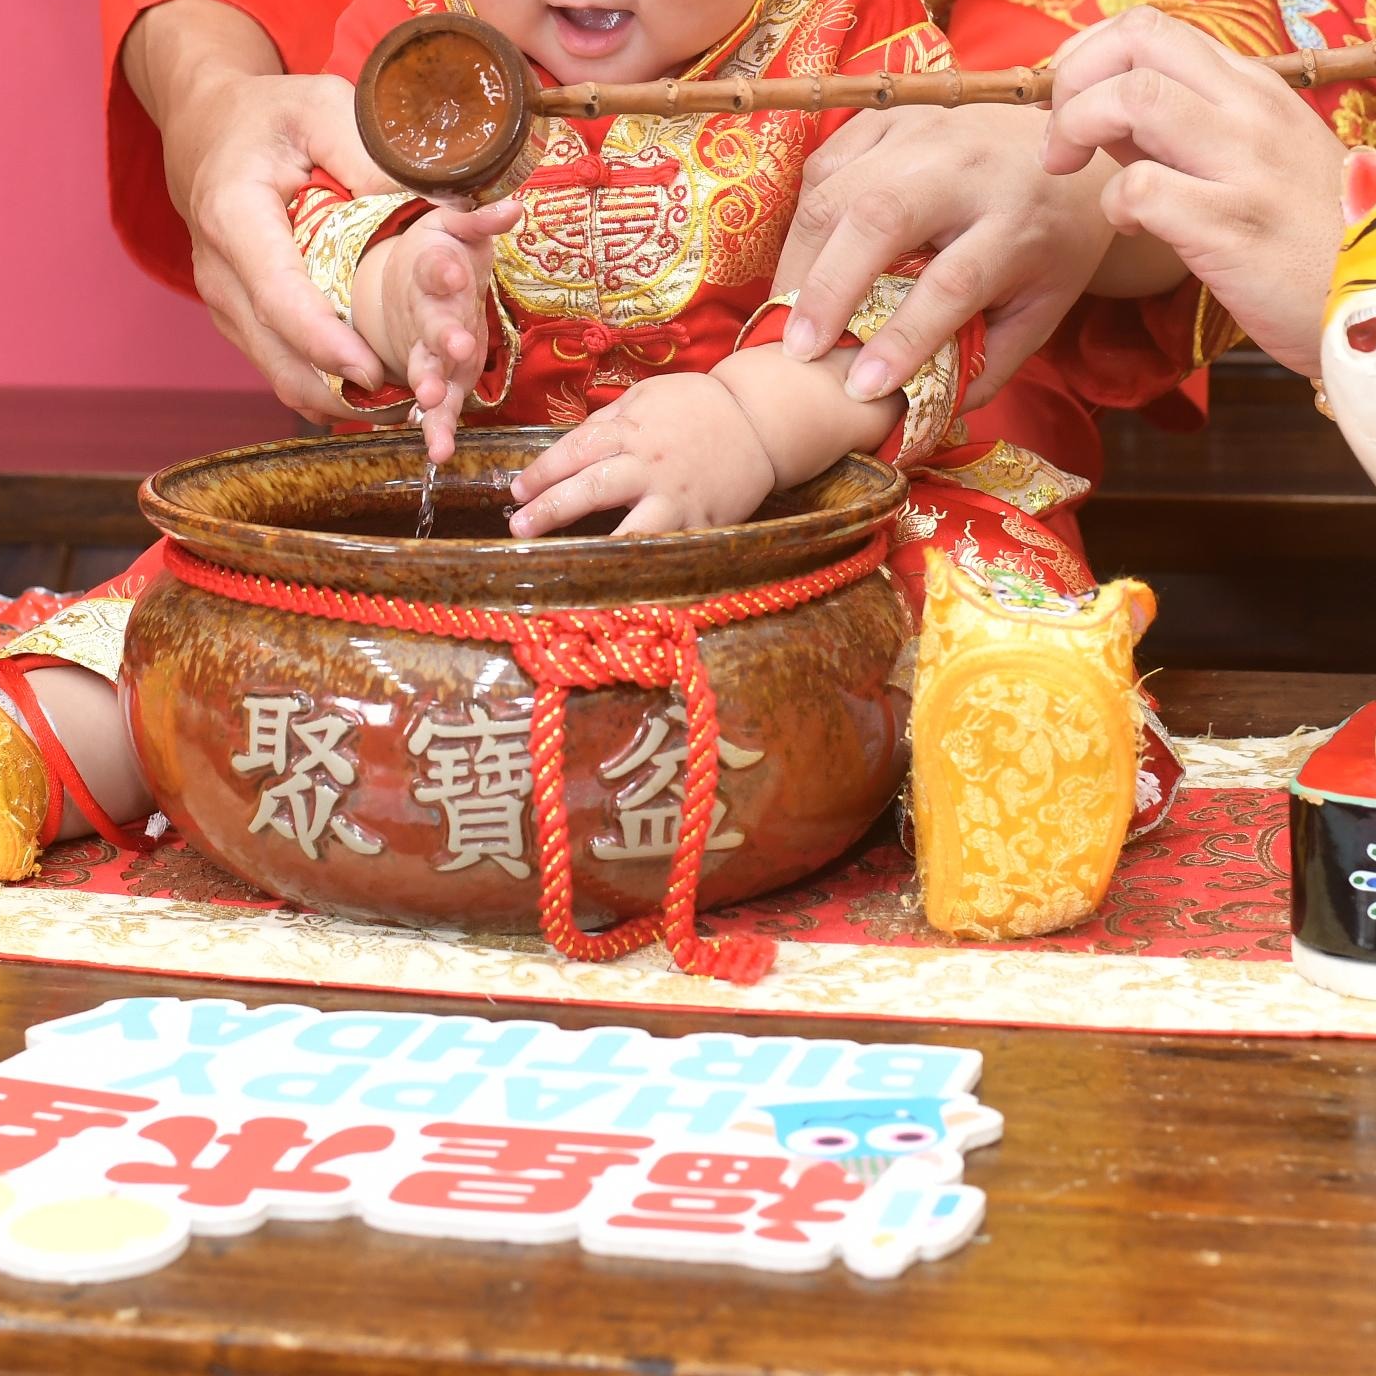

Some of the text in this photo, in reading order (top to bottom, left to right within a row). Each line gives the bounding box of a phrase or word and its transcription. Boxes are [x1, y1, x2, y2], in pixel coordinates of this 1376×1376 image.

[231, 695, 765, 880] 聚寶盆
[59, 997, 960, 1099] BIRTHDAY
[107, 1047, 749, 1136] HAPPY
